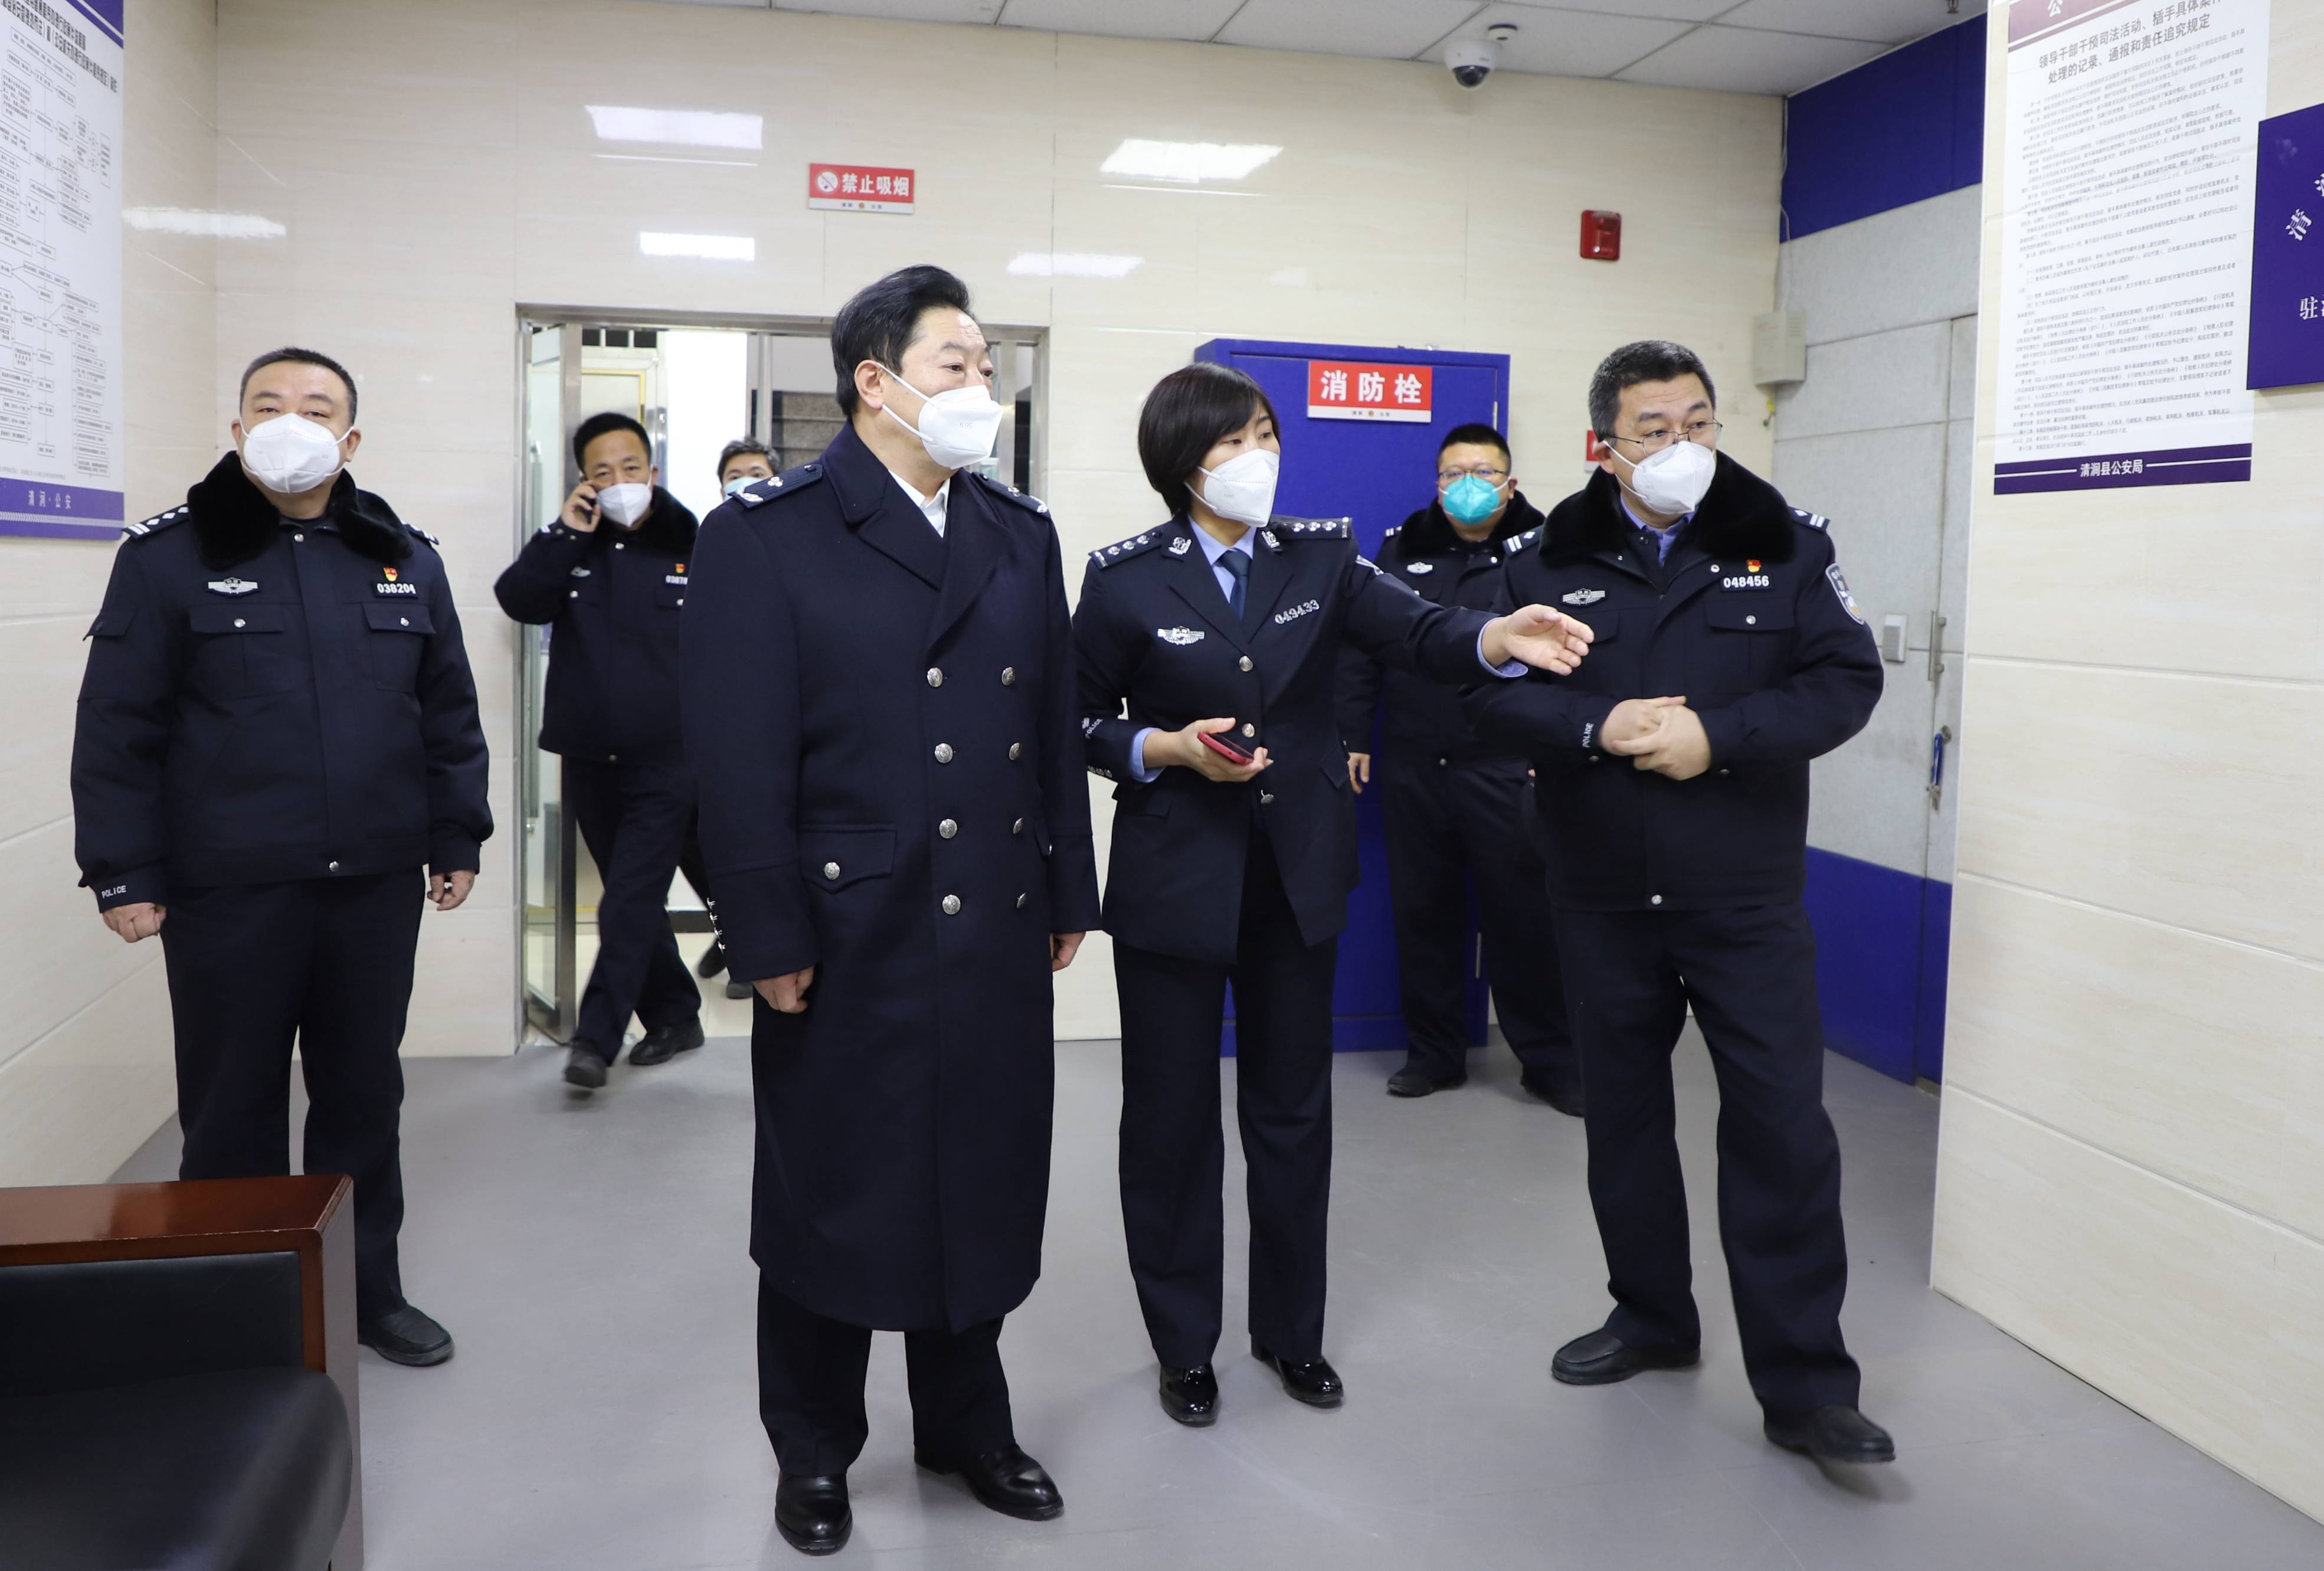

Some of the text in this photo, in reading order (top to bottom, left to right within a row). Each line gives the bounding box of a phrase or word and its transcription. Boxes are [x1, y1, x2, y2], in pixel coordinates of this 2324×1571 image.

[2039, 0, 2221, 68] 领导干部干预司法活动、插手具体案
[2048, 13, 2210, 84] 处理的记录、通报和责任追究规定
[842, 172, 909, 197] 禁止吸烟
[1321, 370, 1422, 404] 消防栓
[2080, 459, 2143, 477] 清涧县公安局
[377, 582, 416, 594] 038204
[1723, 575, 1769, 588] 048456
[1275, 599, 1320, 624] 049433
[1085, 718, 1104, 739] POLICE
[1582, 722, 1595, 748] POLICE
[101, 885, 127, 899] POLICE
